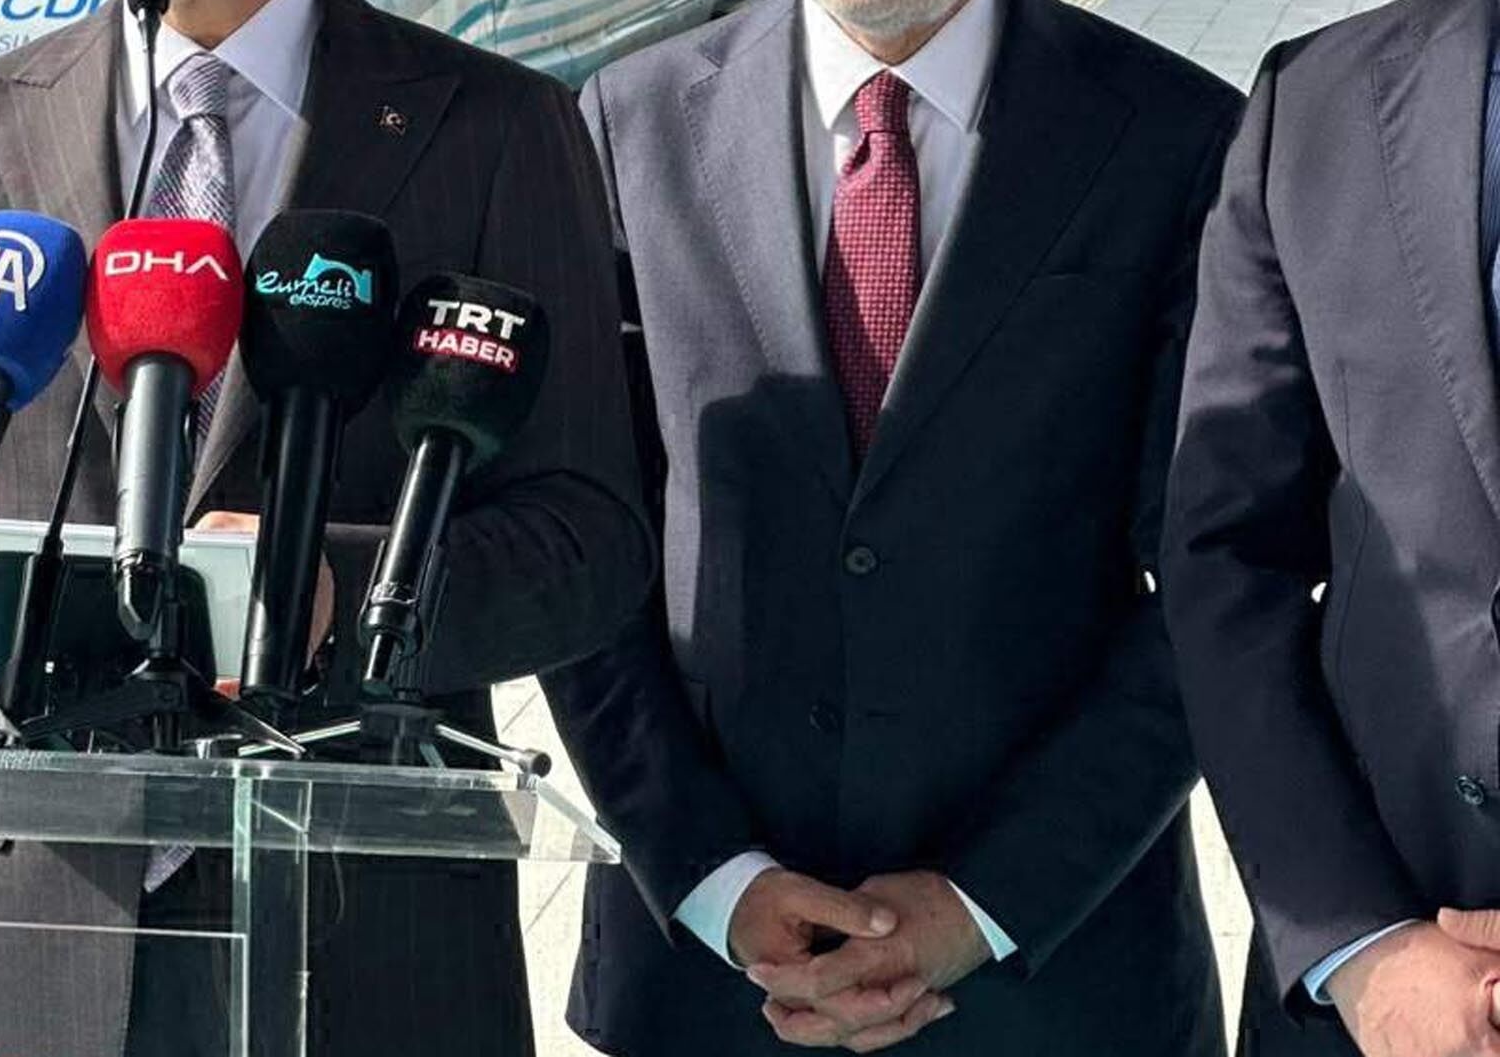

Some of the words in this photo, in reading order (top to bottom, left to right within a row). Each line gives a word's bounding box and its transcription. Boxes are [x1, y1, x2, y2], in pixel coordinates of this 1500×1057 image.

[104, 250, 230, 281] DHA
[427, 299, 526, 340] TRT
[418, 329, 515, 368] HABER
